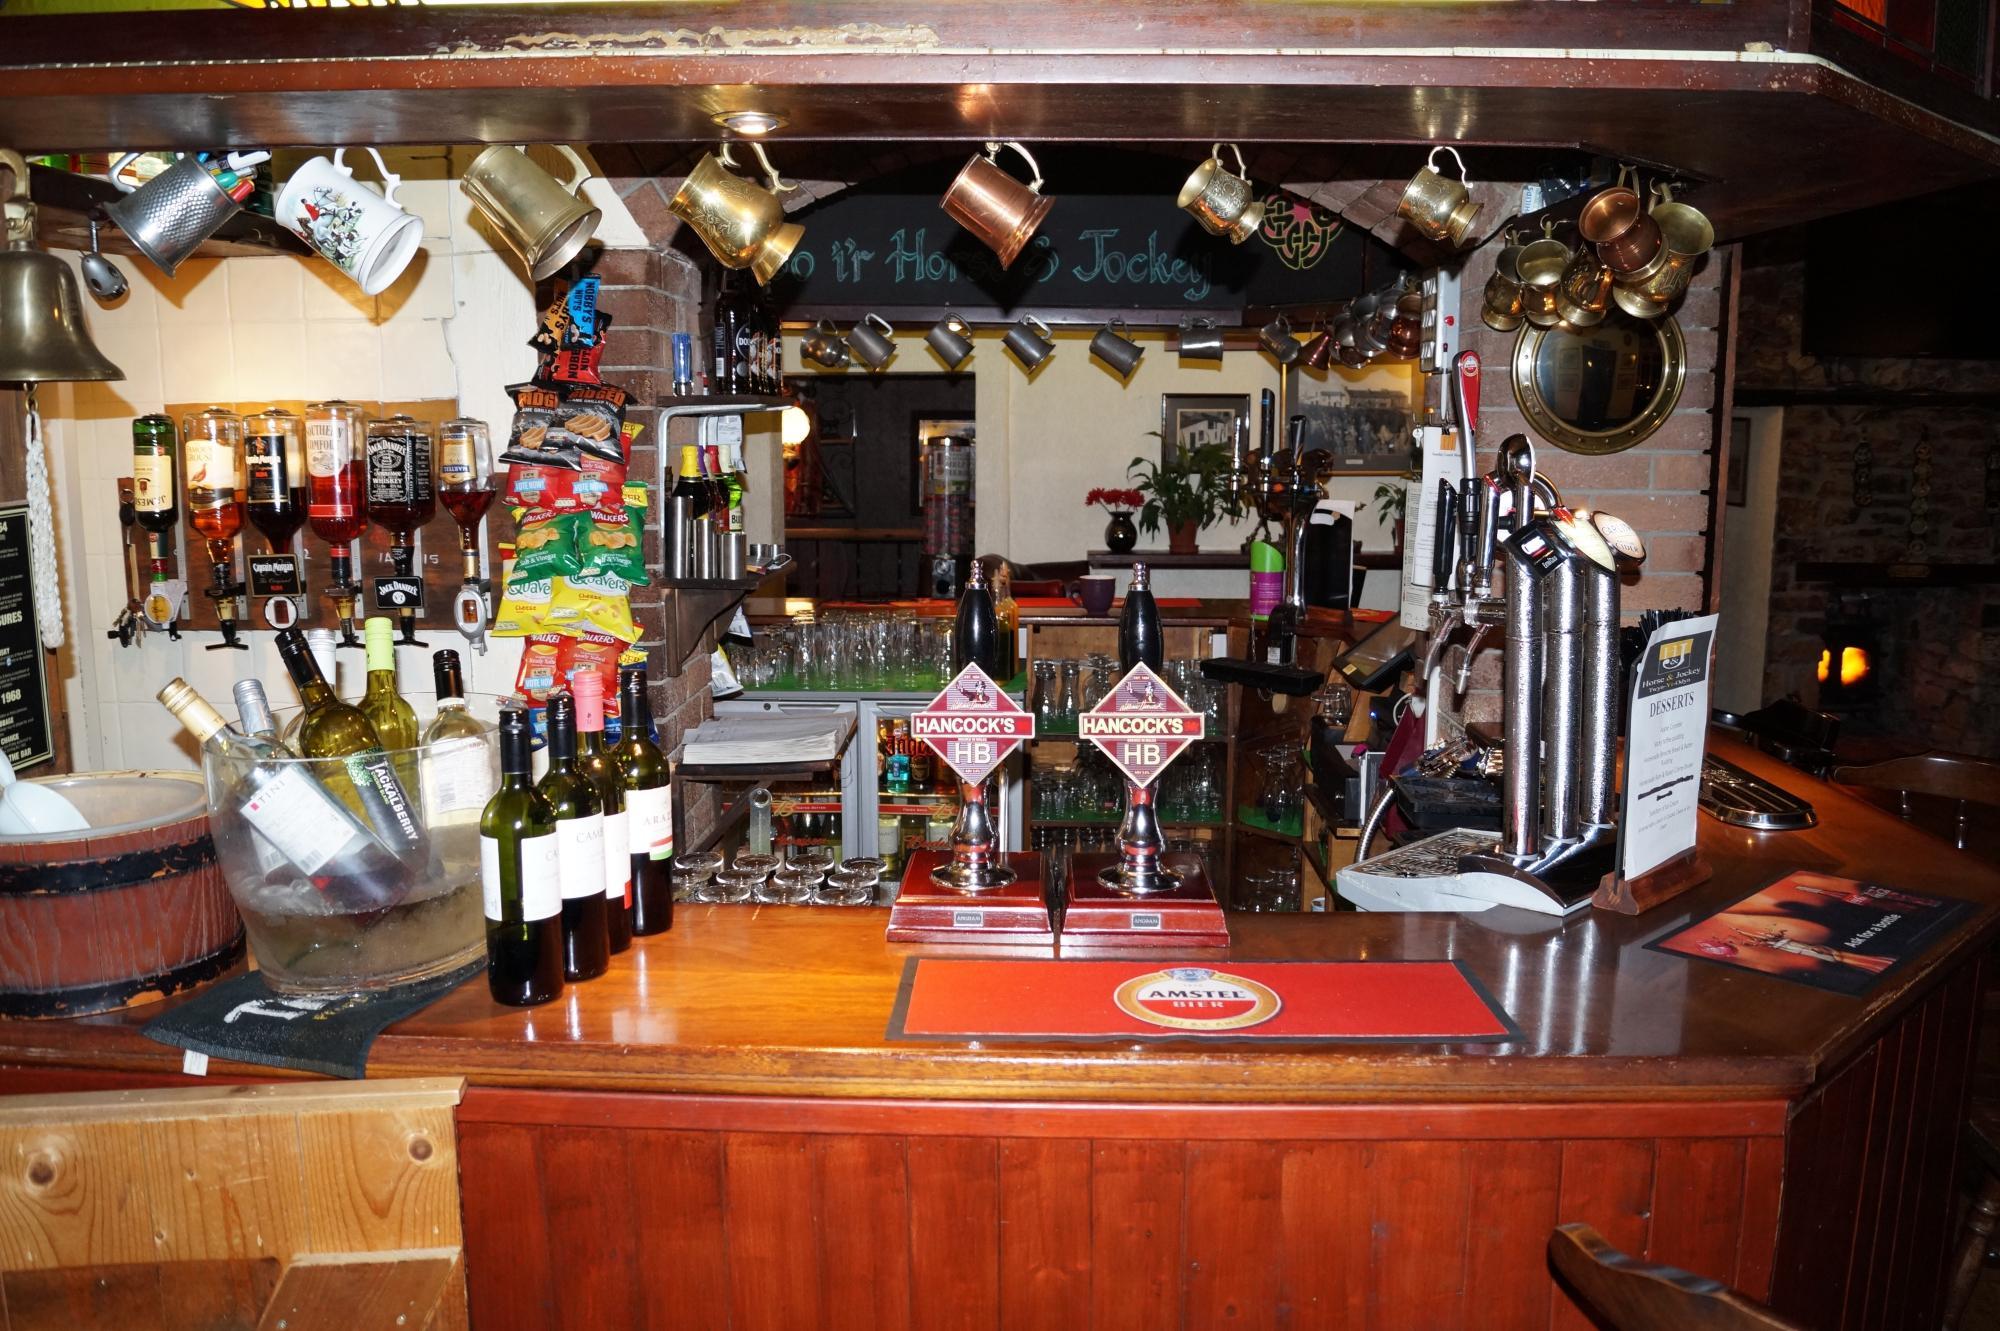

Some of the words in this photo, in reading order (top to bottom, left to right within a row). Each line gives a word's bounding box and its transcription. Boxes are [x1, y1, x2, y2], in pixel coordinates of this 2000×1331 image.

[1525, 187, 1534, 213] HILIPS
[1072, 228, 1211, 301] Jockey
[581, 281, 596, 324] NOBBYS
[518, 391, 557, 408] RIDG
[368, 441, 383, 456] JACK
[590, 510, 629, 523] WALKERS
[252, 562, 273, 573] Captain
[272, 562, 294, 573] Morgan
[423, 553, 440, 565] 15
[378, 584, 394, 596] JACK
[393, 580, 418, 596] DANIEL'S
[507, 579, 550, 596] Quave
[569, 574, 629, 592] Quavers
[0, 610, 23, 628] SURES
[530, 633, 561, 644] WALKE
[1642, 677, 1665, 688] Horse
[1666, 673, 1673, 681] &
[1675, 666, 1701, 679] Jockey
[1, 688, 22, 705] 1968
[1649, 691, 1695, 718] DESSERTS
[915, 716, 1016, 734] HANCOCK'S
[1083, 717, 1184, 734] HANCOCK'S
[954, 742, 991, 764] HB
[1124, 744, 1161, 765] HB
[364, 758, 420, 841] JACKALBERRY
[1843, 937, 1867, 949] Ask
[1856, 929, 1877, 940] for
[1872, 917, 1901, 929] bottle
[1149, 989, 1245, 999] AMSTEL
[1172, 1000, 1225, 1009] BIER
